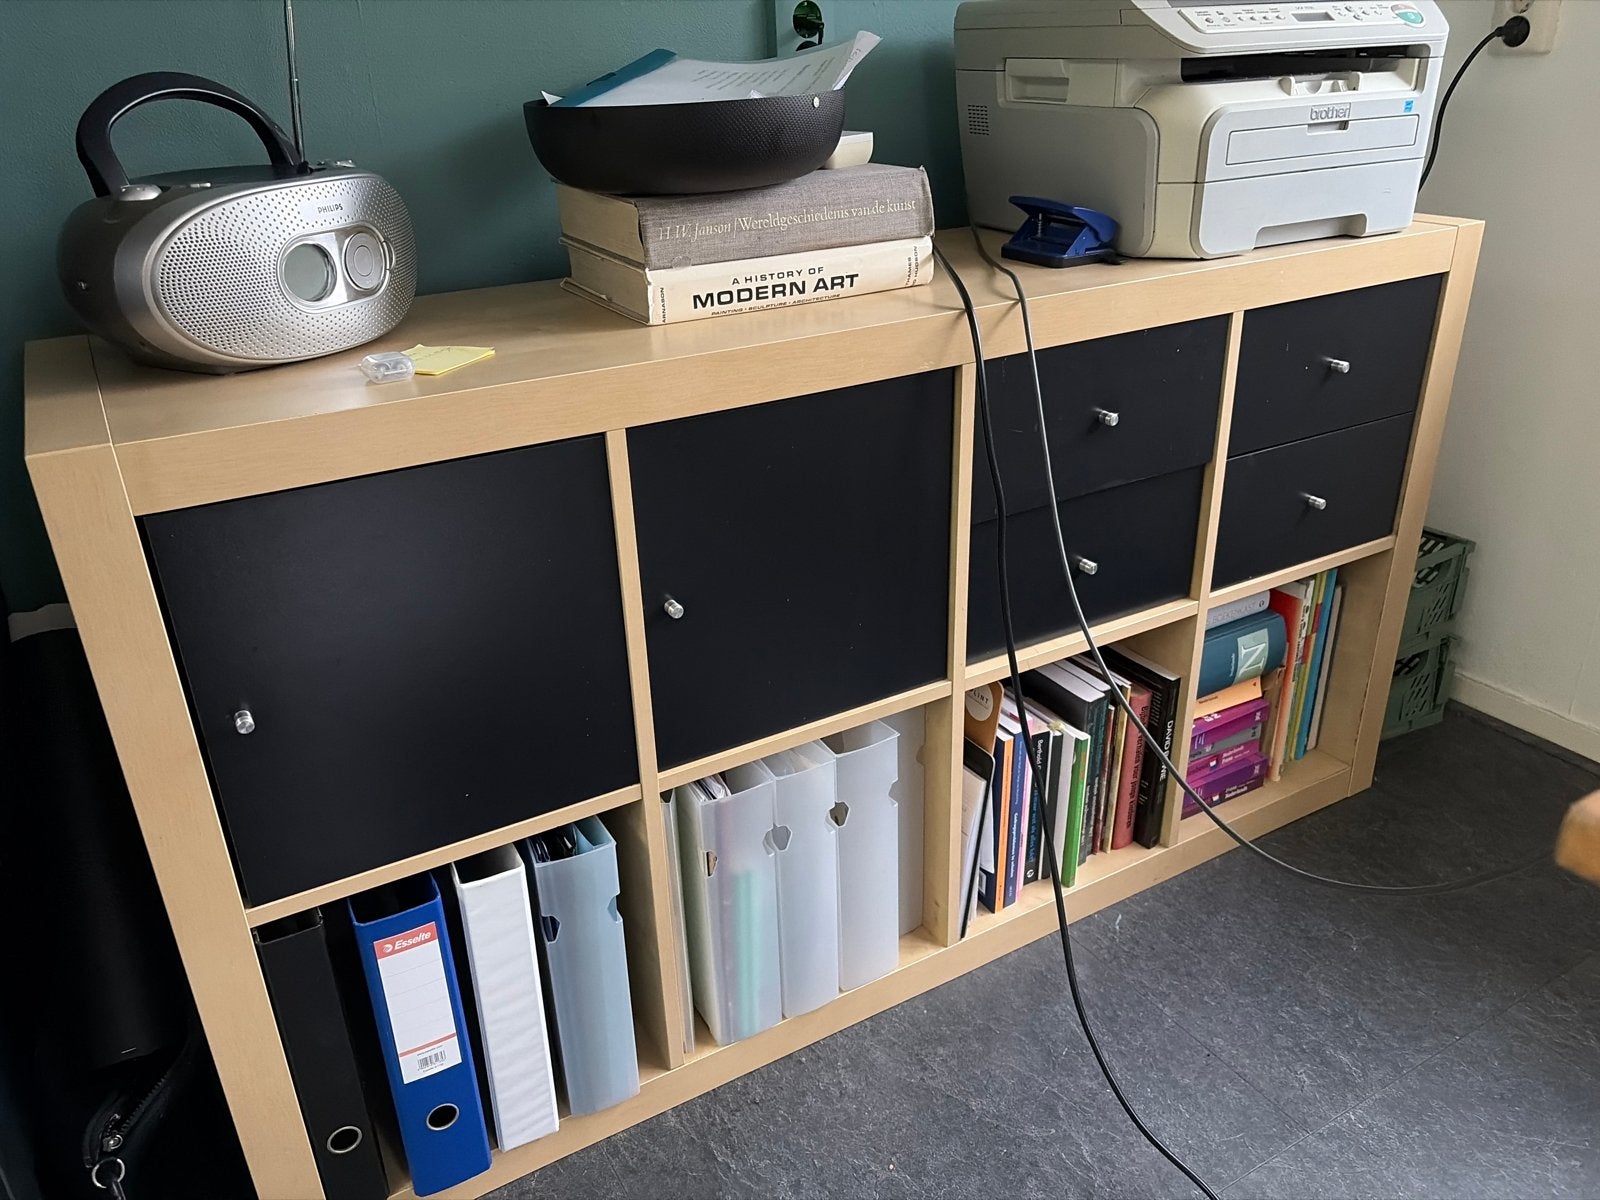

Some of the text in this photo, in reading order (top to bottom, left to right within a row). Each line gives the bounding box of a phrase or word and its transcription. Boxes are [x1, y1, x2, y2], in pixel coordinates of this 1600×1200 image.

[1310, 105, 1350, 121] brother
[317, 203, 344, 214] PHILIPS
[691, 217, 732, 242] Janson
[851, 206, 871, 217] van
[871, 201, 885, 215] de
[886, 199, 916, 214] kunst
[912, 245, 920, 278] HUDSON
[731, 265, 824, 286] A HISTORY OF
[692, 272, 859, 310] MODERN ART
[711, 293, 841, 316] PAINTING SCULPTURE ARCHITECTURE
[659, 287, 667, 324] ARNASON
[1163, 719, 1174, 750] DAVID
[394, 931, 432, 951] Esselte
